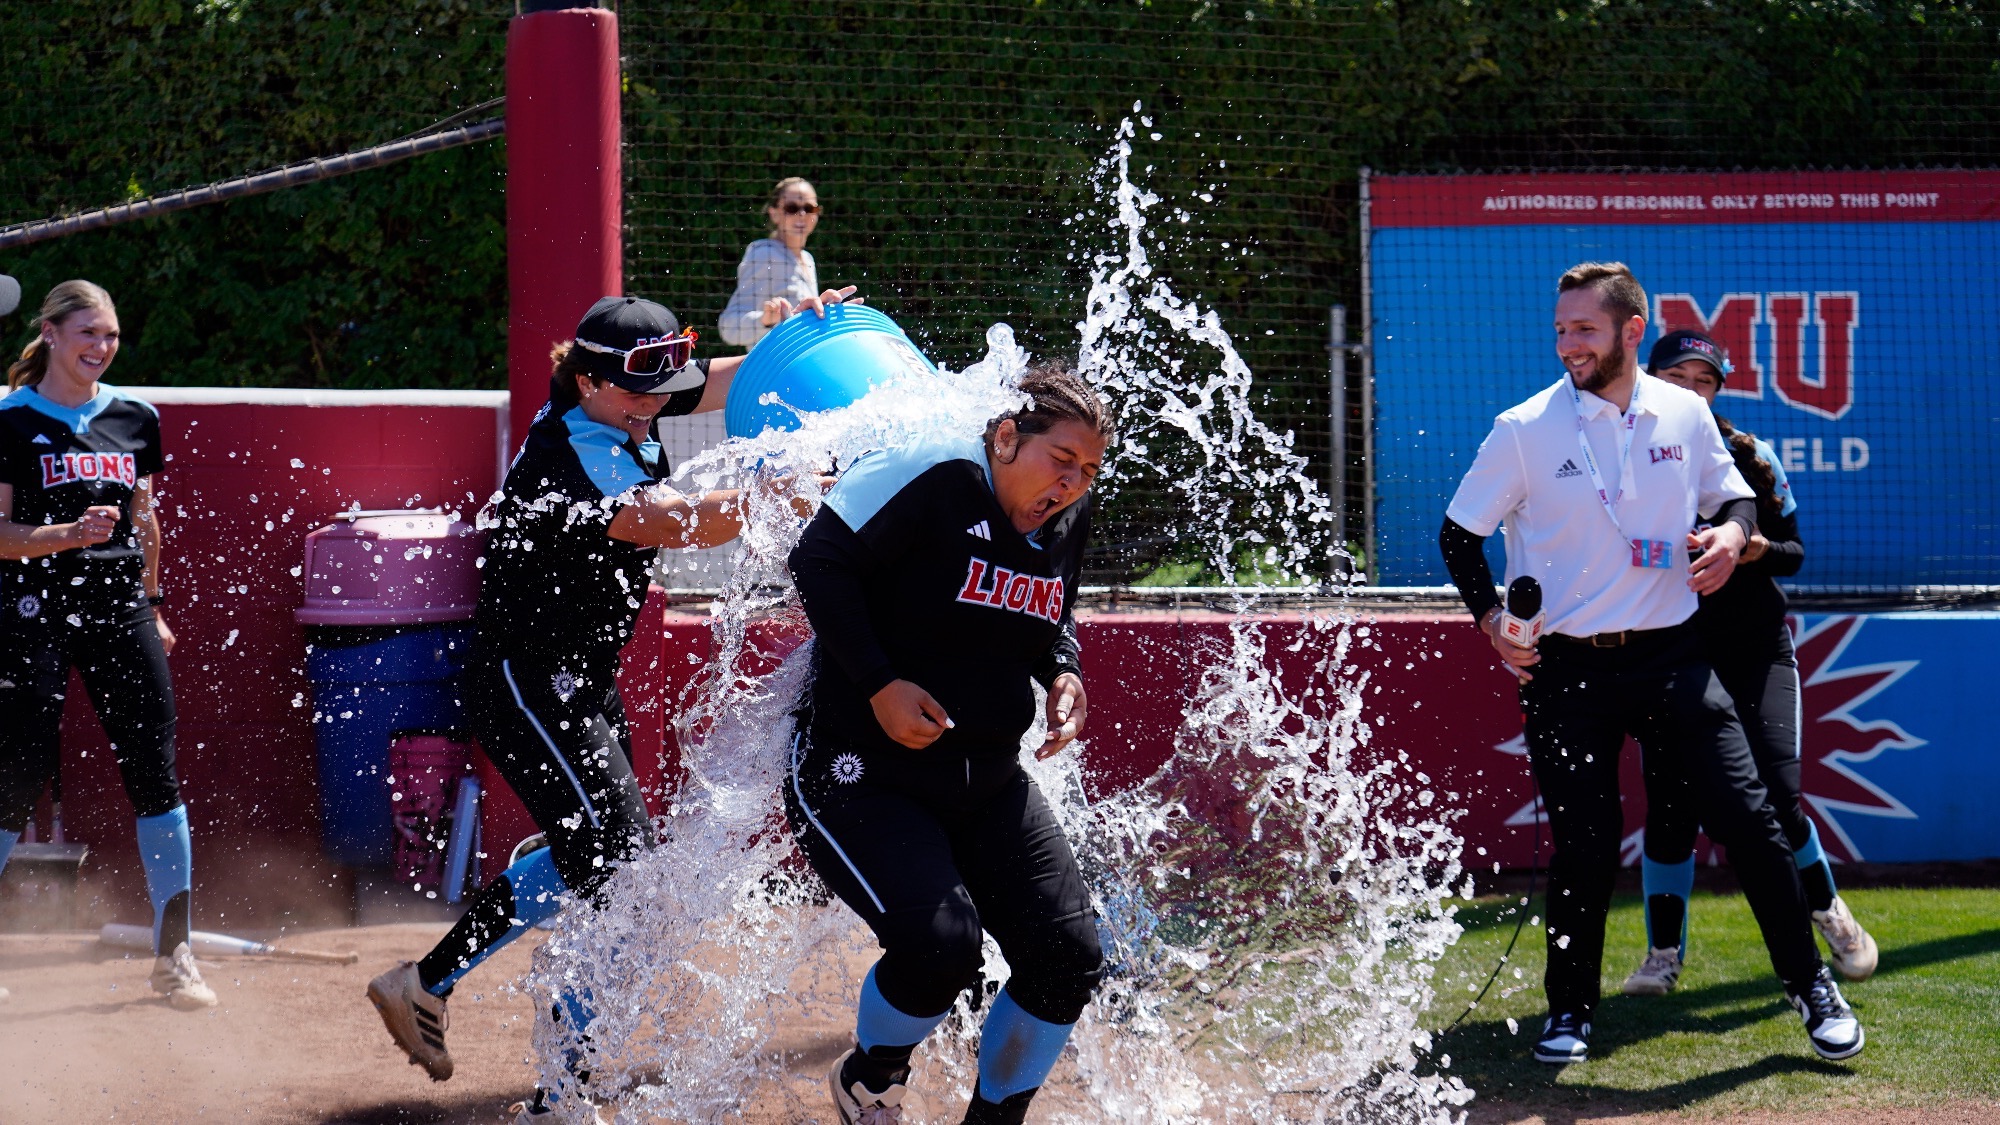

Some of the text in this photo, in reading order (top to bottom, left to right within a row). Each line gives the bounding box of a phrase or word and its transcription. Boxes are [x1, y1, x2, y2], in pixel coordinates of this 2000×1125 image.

[1483, 193, 1939, 210] AUTHORIZED PERSONNEL ONLY BEYOND THIS POINT
[1653, 290, 1859, 421] MU
[40, 452, 136, 490] LIONS
[1648, 445, 1683, 463] LMU
[1769, 437, 1870, 472] ELD
[1555, 469, 1583, 479] adidas
[955, 556, 1064, 625] LIONS
